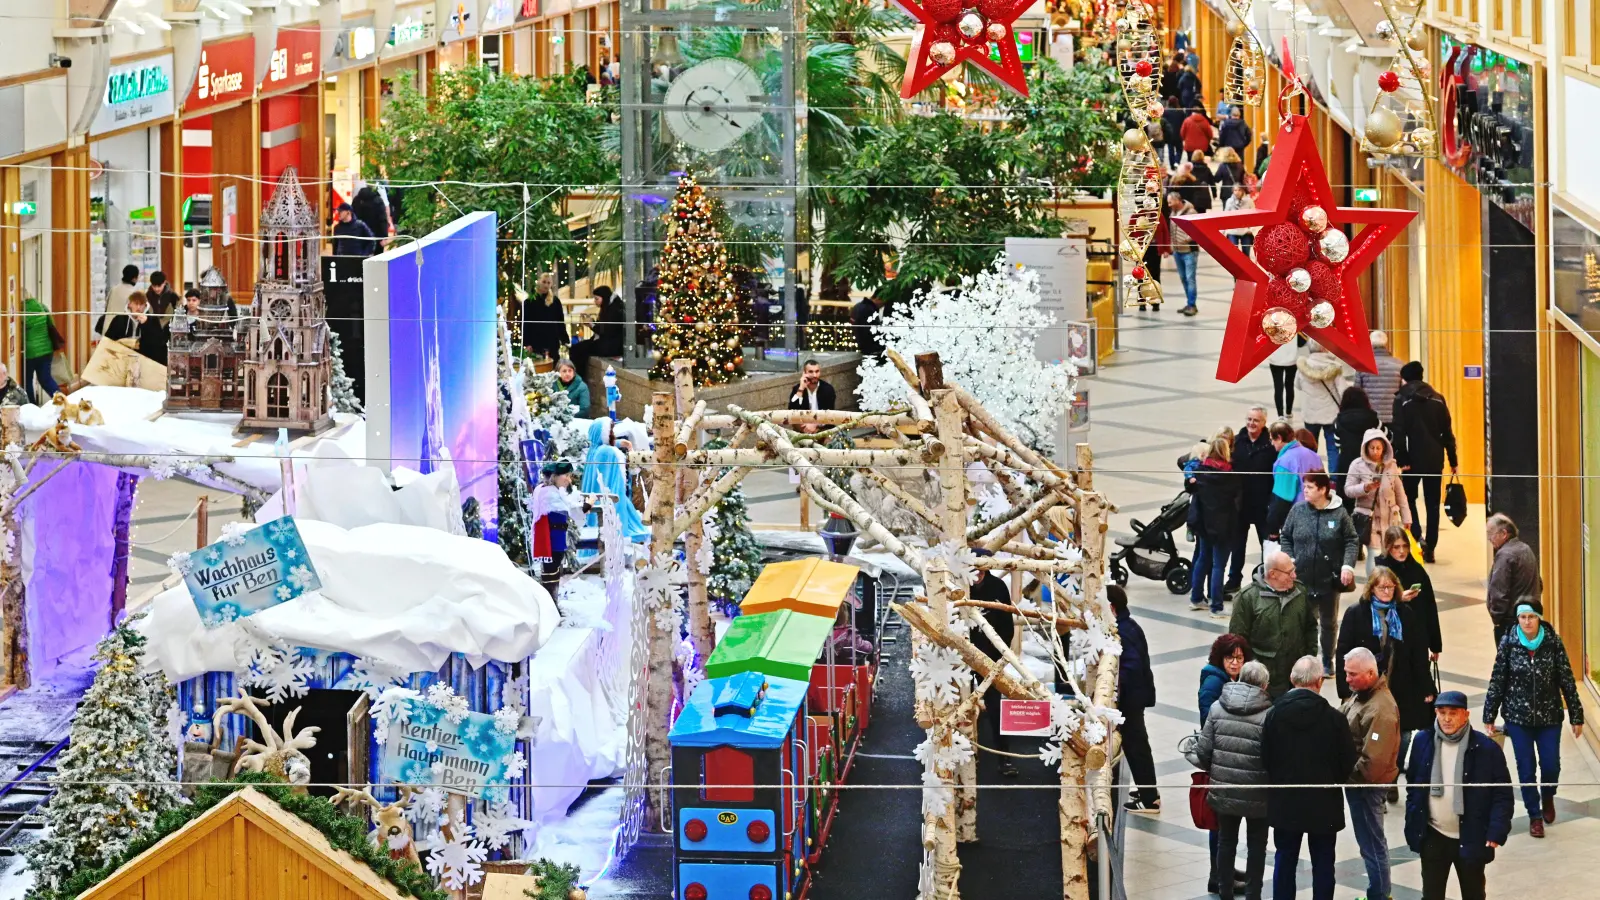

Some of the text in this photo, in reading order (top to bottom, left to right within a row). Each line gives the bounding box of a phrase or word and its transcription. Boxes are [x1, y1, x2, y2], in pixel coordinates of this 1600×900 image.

[210, 69, 243, 101] Sparkasse
[194, 547, 276, 587] Wachhaus
[211, 568, 278, 602] für Ben
[400, 718, 464, 746] Rentier-
[397, 743, 490, 776] Hauptmann
